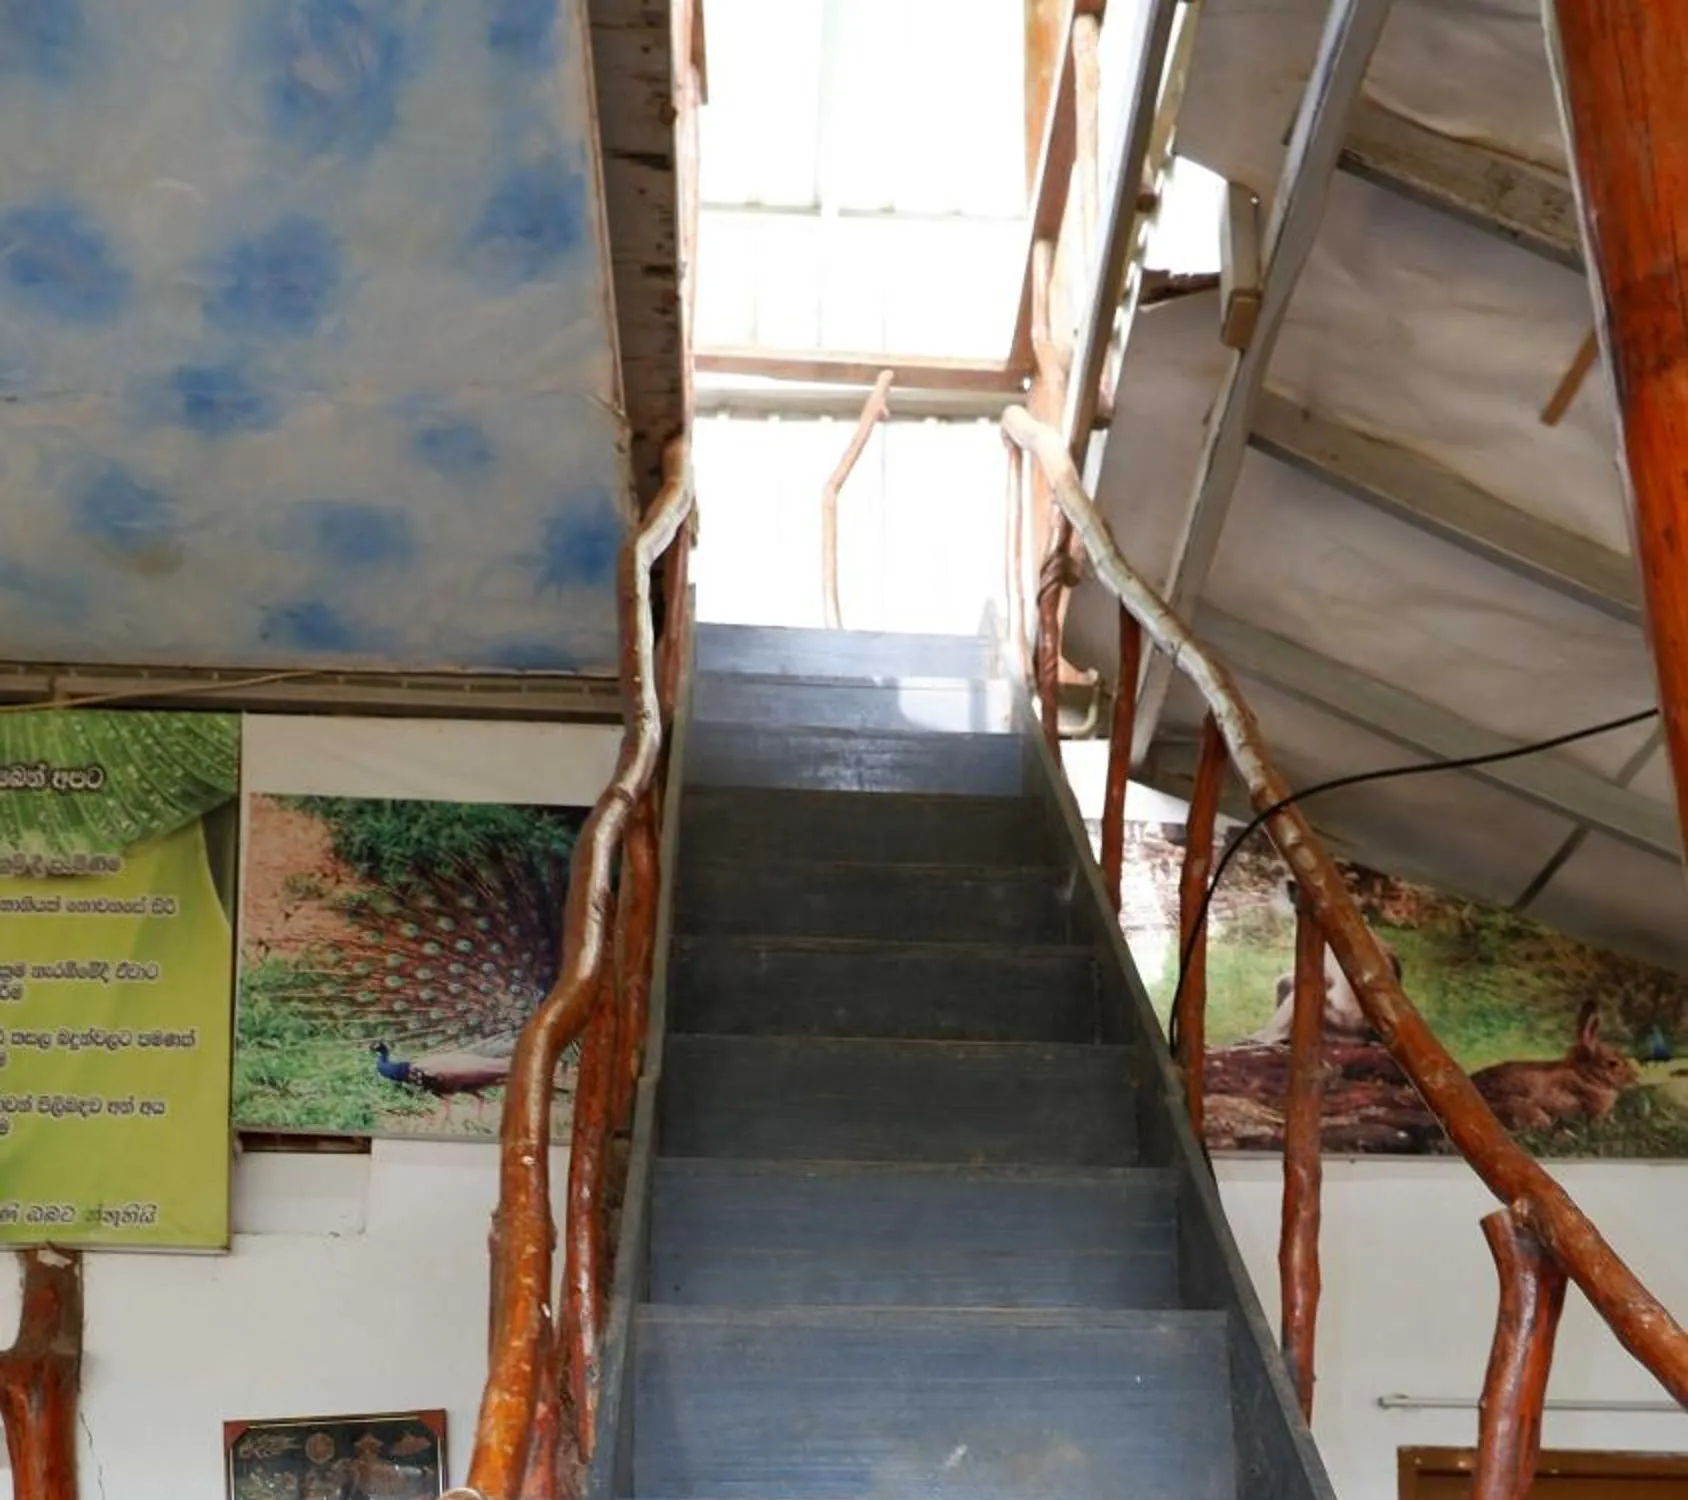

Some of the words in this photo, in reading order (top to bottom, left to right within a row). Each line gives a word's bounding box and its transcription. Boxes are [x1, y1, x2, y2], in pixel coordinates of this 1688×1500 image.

[52, 766, 104, 790] අපට
[139, 1101, 166, 1116] අය
[26, 1204, 76, 1223] ඔබට
